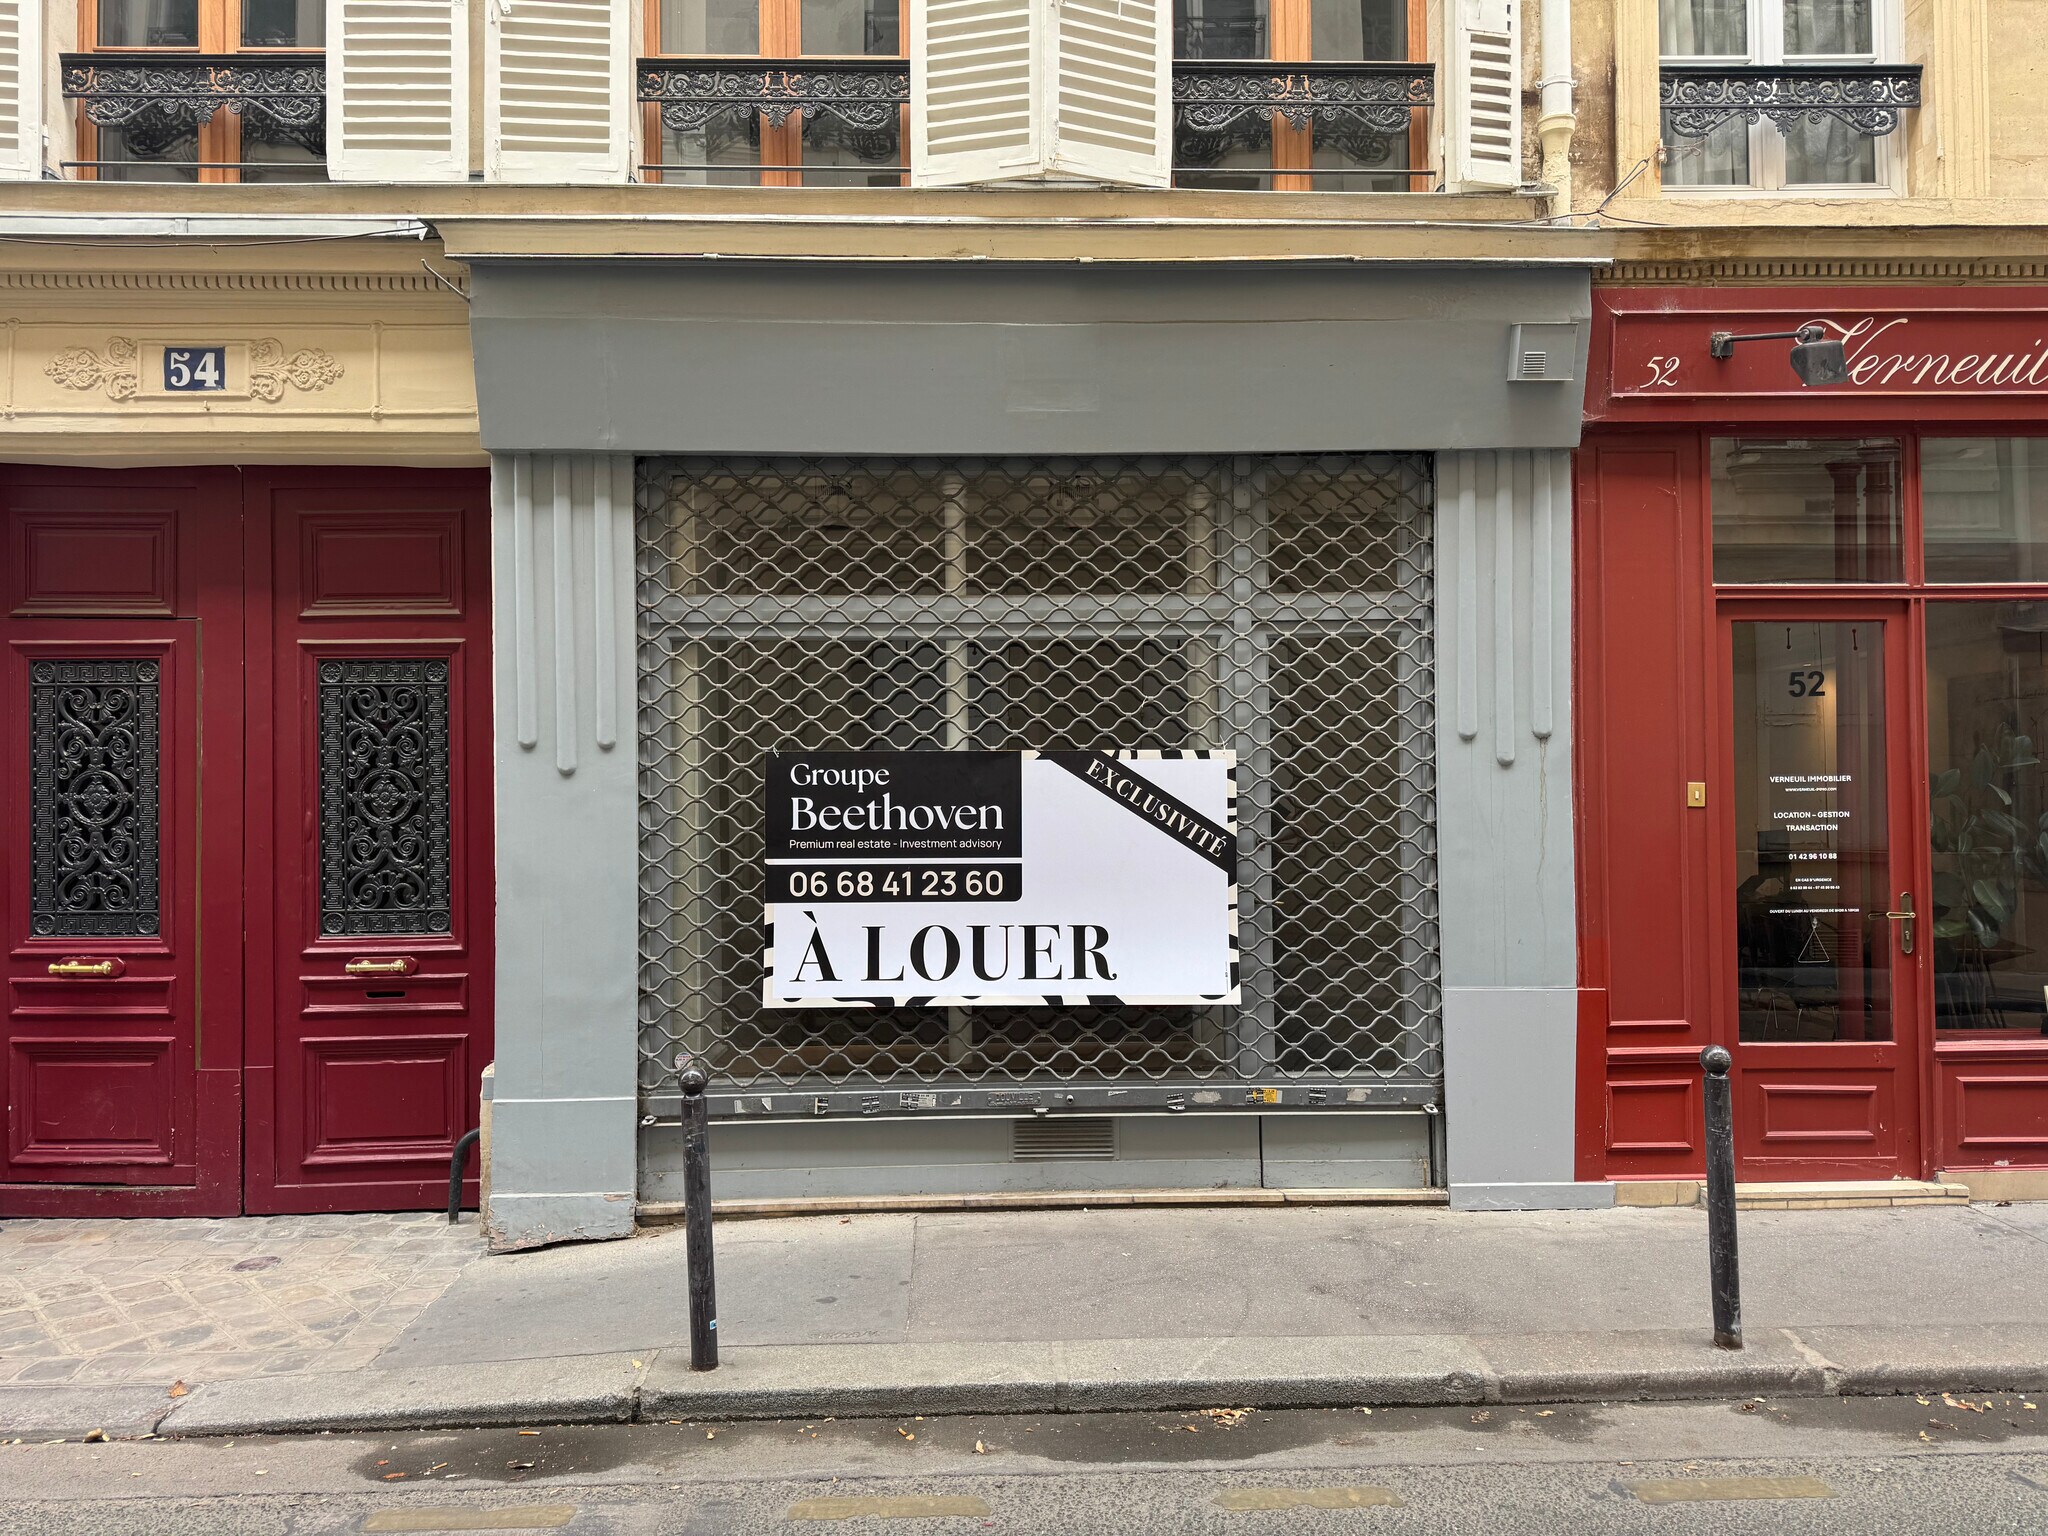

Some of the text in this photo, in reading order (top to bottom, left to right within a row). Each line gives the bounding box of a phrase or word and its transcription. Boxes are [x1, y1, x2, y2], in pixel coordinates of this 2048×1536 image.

[170, 352, 219, 386] 54
[1640, 356, 1680, 388] 52
[1788, 671, 1826, 697] 52
[790, 763, 890, 793] Groupe
[1769, 774, 1852, 783] VERNEUIL IMMOBILIER
[791, 792, 1004, 831] Beethoven
[1085, 758, 1228, 858] EXCLUSIVITÉ
[1773, 811, 1811, 819] LOCATION
[1785, 824, 1839, 832] TRANSACTION
[789, 839, 834, 849] Premium
[836, 839, 855, 849] real
[857, 839, 891, 849] estate
[900, 839, 957, 849] Investment
[959, 839, 1002, 850] advisory
[789, 870, 1003, 897] 06 68 41 23 60
[789, 911, 1117, 982] À LOUER
